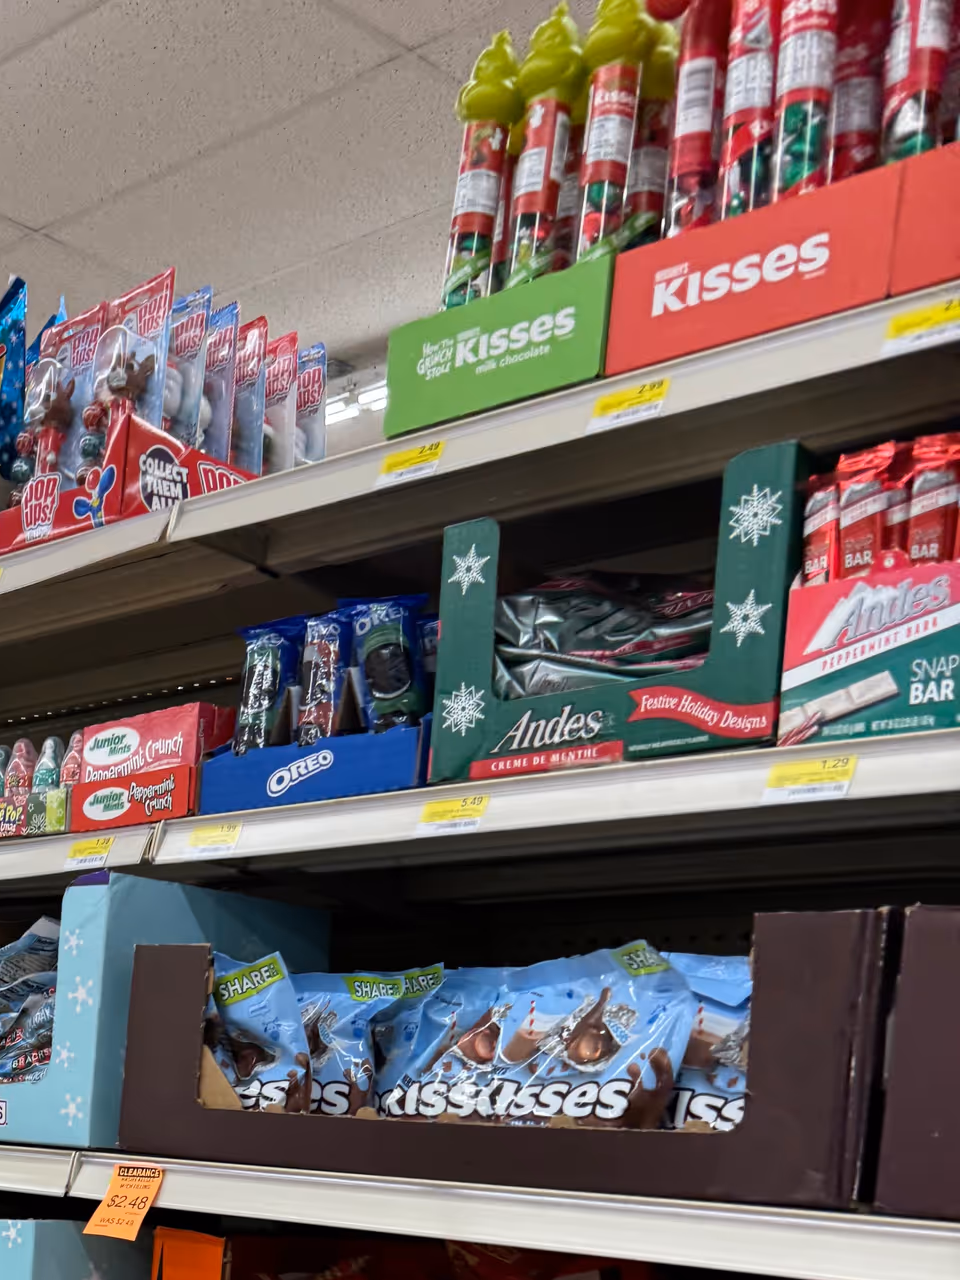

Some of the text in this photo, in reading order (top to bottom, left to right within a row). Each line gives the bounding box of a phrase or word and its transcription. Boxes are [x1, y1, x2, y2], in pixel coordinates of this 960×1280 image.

[475, 344, 552, 375] milk chocolate
[638, 380, 664, 395] 2.99
[418, 440, 441, 456] 2.49
[140, 455, 188, 481] COLLECT
[147, 481, 183, 497] THEM
[844, 551, 873, 568] BAR
[910, 543, 939, 560] BAR
[821, 627, 900, 671] PEPPERMINT
[911, 653, 960, 682] SNAP
[909, 678, 955, 705] BAR
[640, 693, 768, 733] Festive Holiday Designs
[489, 704, 604, 754] Andes
[89, 733, 127, 752] Junior
[107, 743, 132, 757] Mints
[145, 731, 184, 761] Crunch
[491, 747, 598, 772] CREME DE MENTHE
[820, 757, 851, 770] 1.29
[267, 749, 334, 798] OREO
[88, 790, 125, 807] Junior
[128, 774, 175, 804] Peppermint
[102, 801, 125, 813] Mints
[144, 793, 172, 816] Crunch
[461, 796, 483, 808] 5.49
[219, 823, 237, 833] 1.99
[218, 966, 272, 1001] SHARE
[119, 1168, 161, 1178] CLEARANCE
[107, 1194, 149, 1210] $2.48
